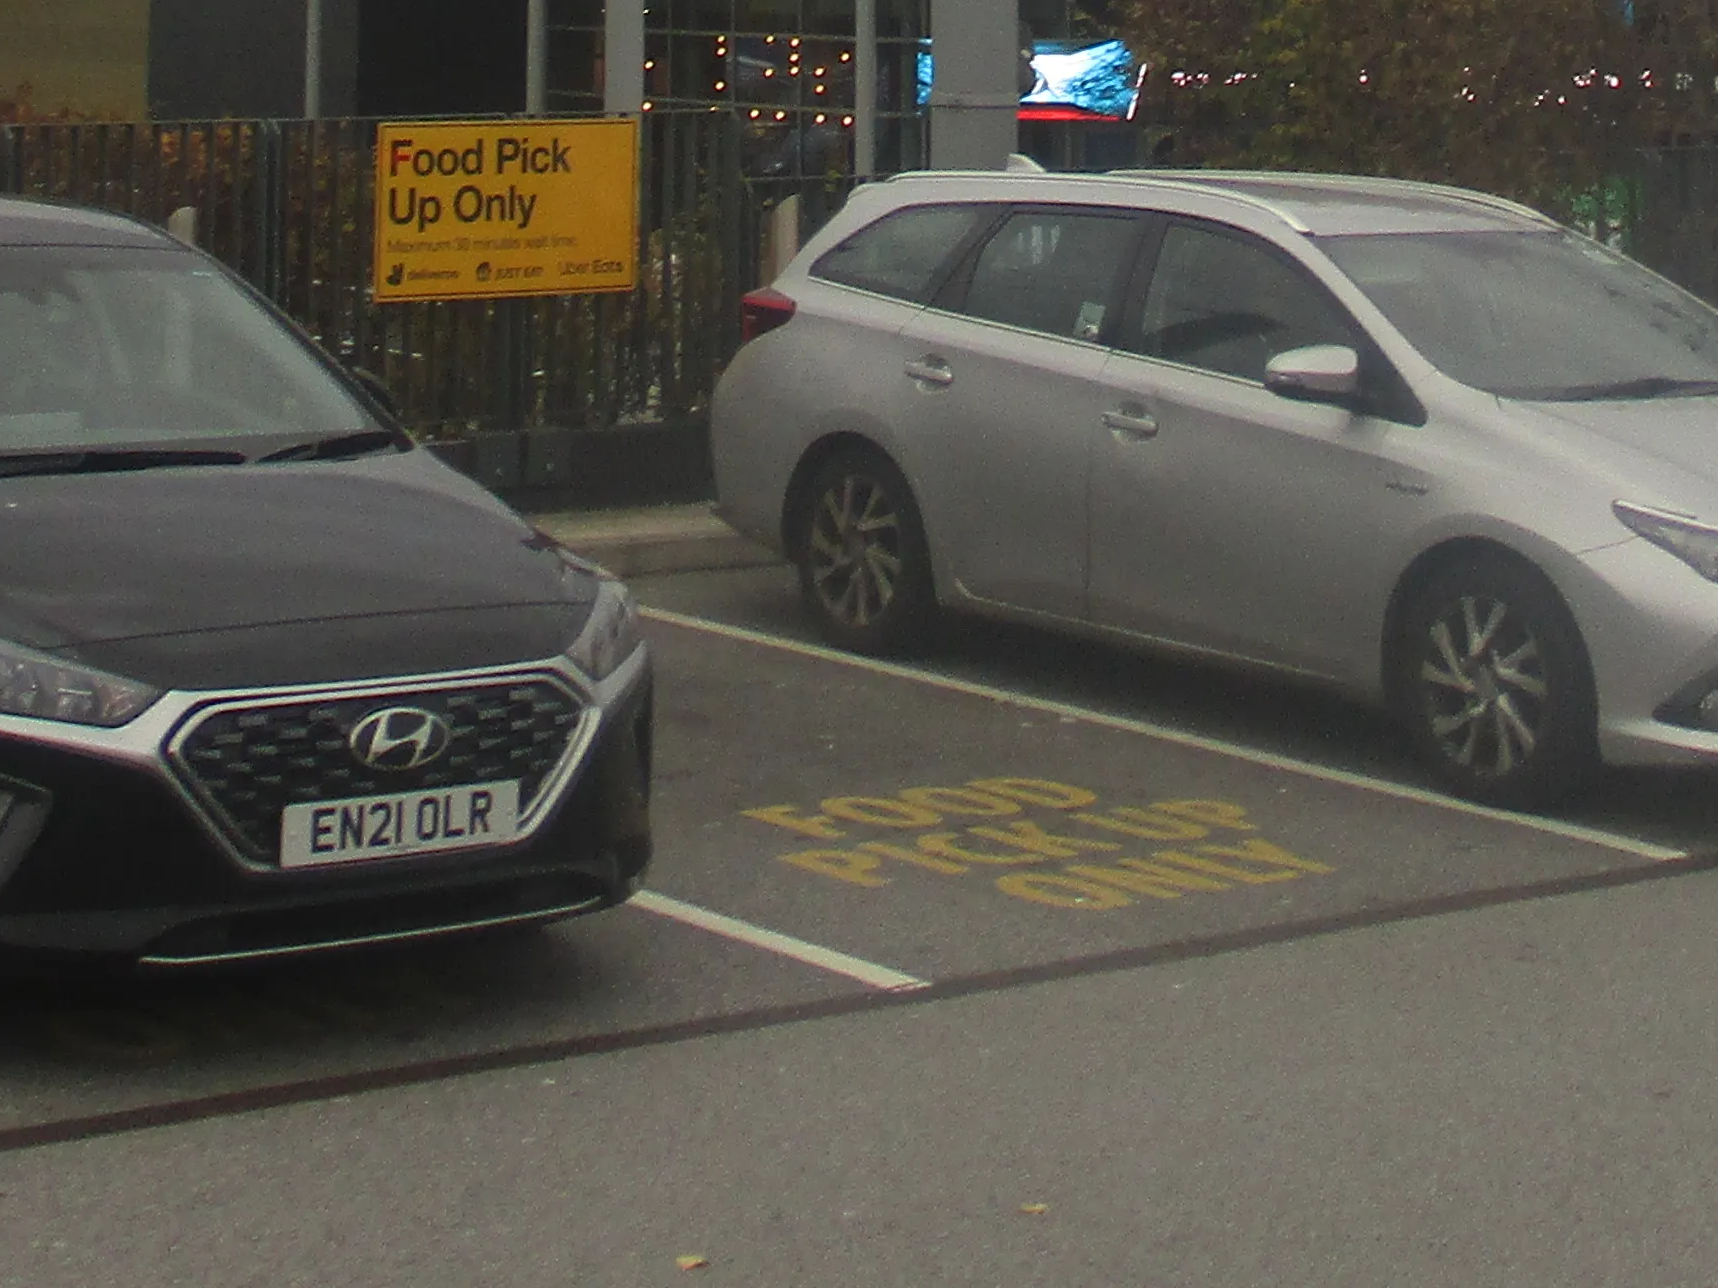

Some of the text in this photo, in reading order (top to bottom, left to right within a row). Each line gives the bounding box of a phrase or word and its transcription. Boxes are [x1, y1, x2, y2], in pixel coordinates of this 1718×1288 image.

[389, 137, 571, 176] Food Pick
[388, 185, 536, 232] Up Only
[311, 790, 493, 854] EN21 OLR
[740, 776, 1097, 840] FOOD
[777, 799, 1260, 888] PICK UP
[996, 837, 1337, 911] ONLY
